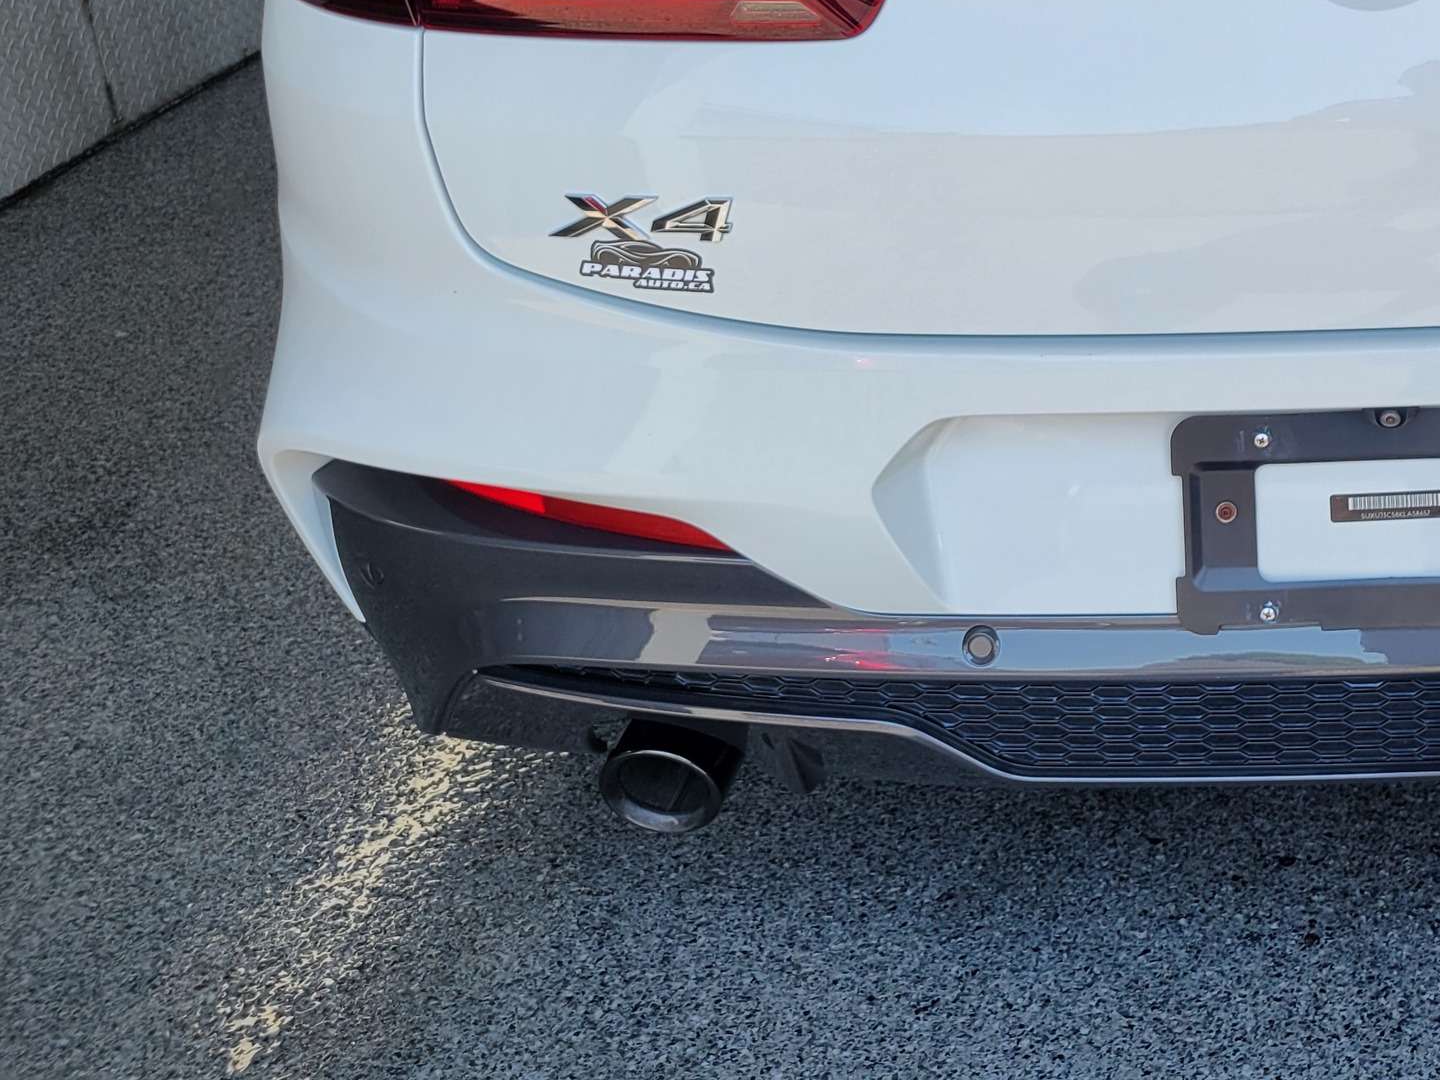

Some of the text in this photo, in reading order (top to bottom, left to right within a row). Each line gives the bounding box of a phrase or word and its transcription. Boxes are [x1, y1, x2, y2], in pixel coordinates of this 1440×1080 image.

[548, 193, 734, 244] X4
[580, 260, 715, 283] PARADIS
[633, 278, 713, 292] AUTO.CA
